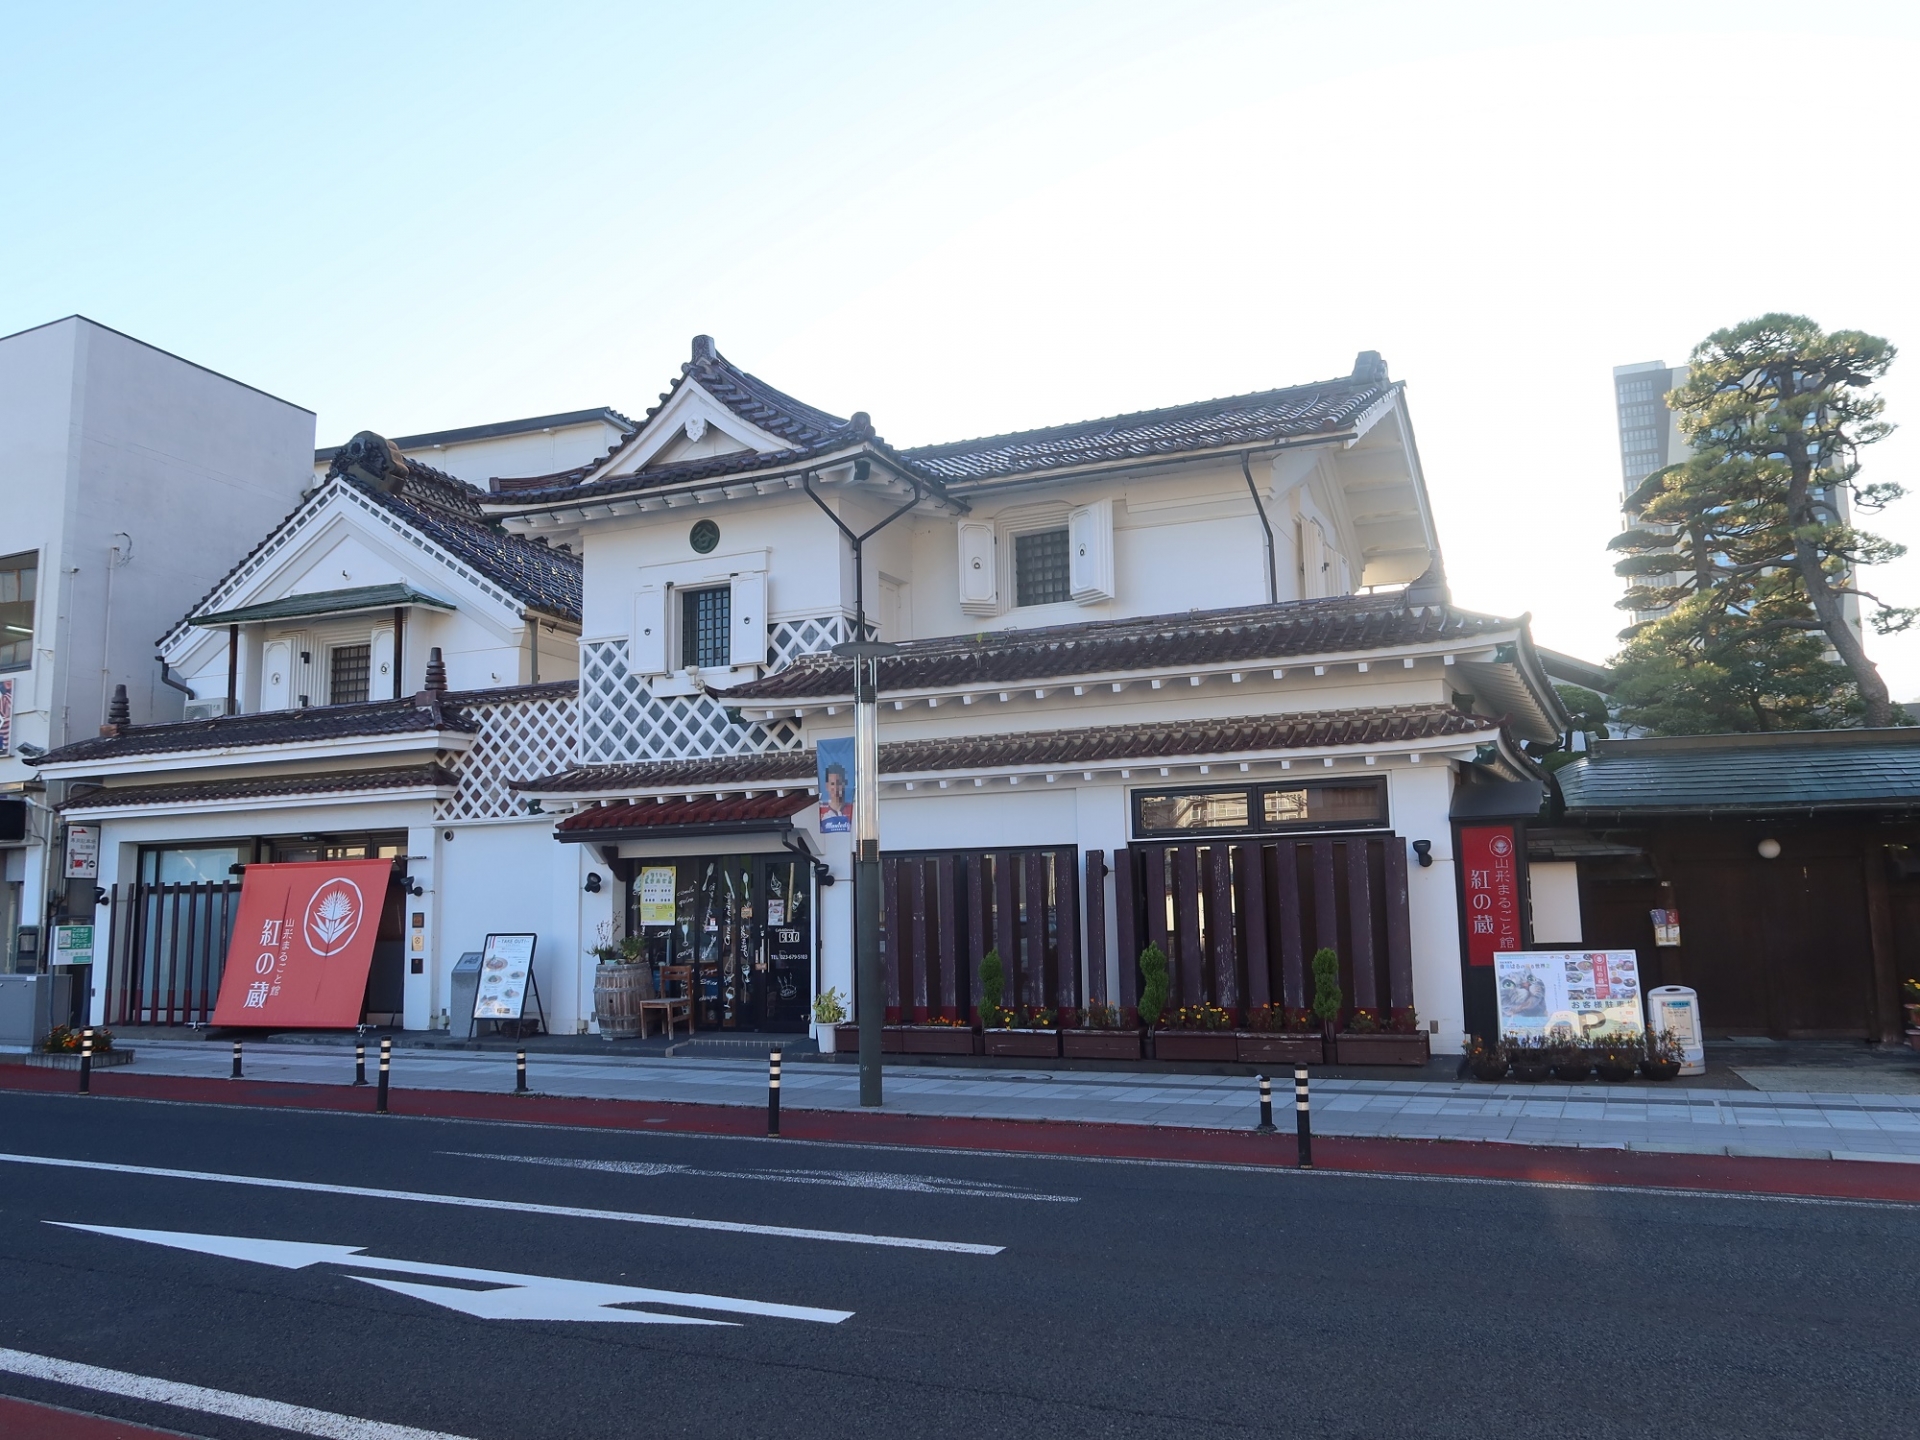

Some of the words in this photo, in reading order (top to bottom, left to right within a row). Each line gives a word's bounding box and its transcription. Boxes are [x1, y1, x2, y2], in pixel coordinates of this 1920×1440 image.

[1470, 869, 1495, 935] 紅の蔵
[1495, 857, 1515, 949] 山形まるごと館
[243, 918, 283, 1009] 紅の蔵
[269, 917, 295, 997] 山形まるごと館
